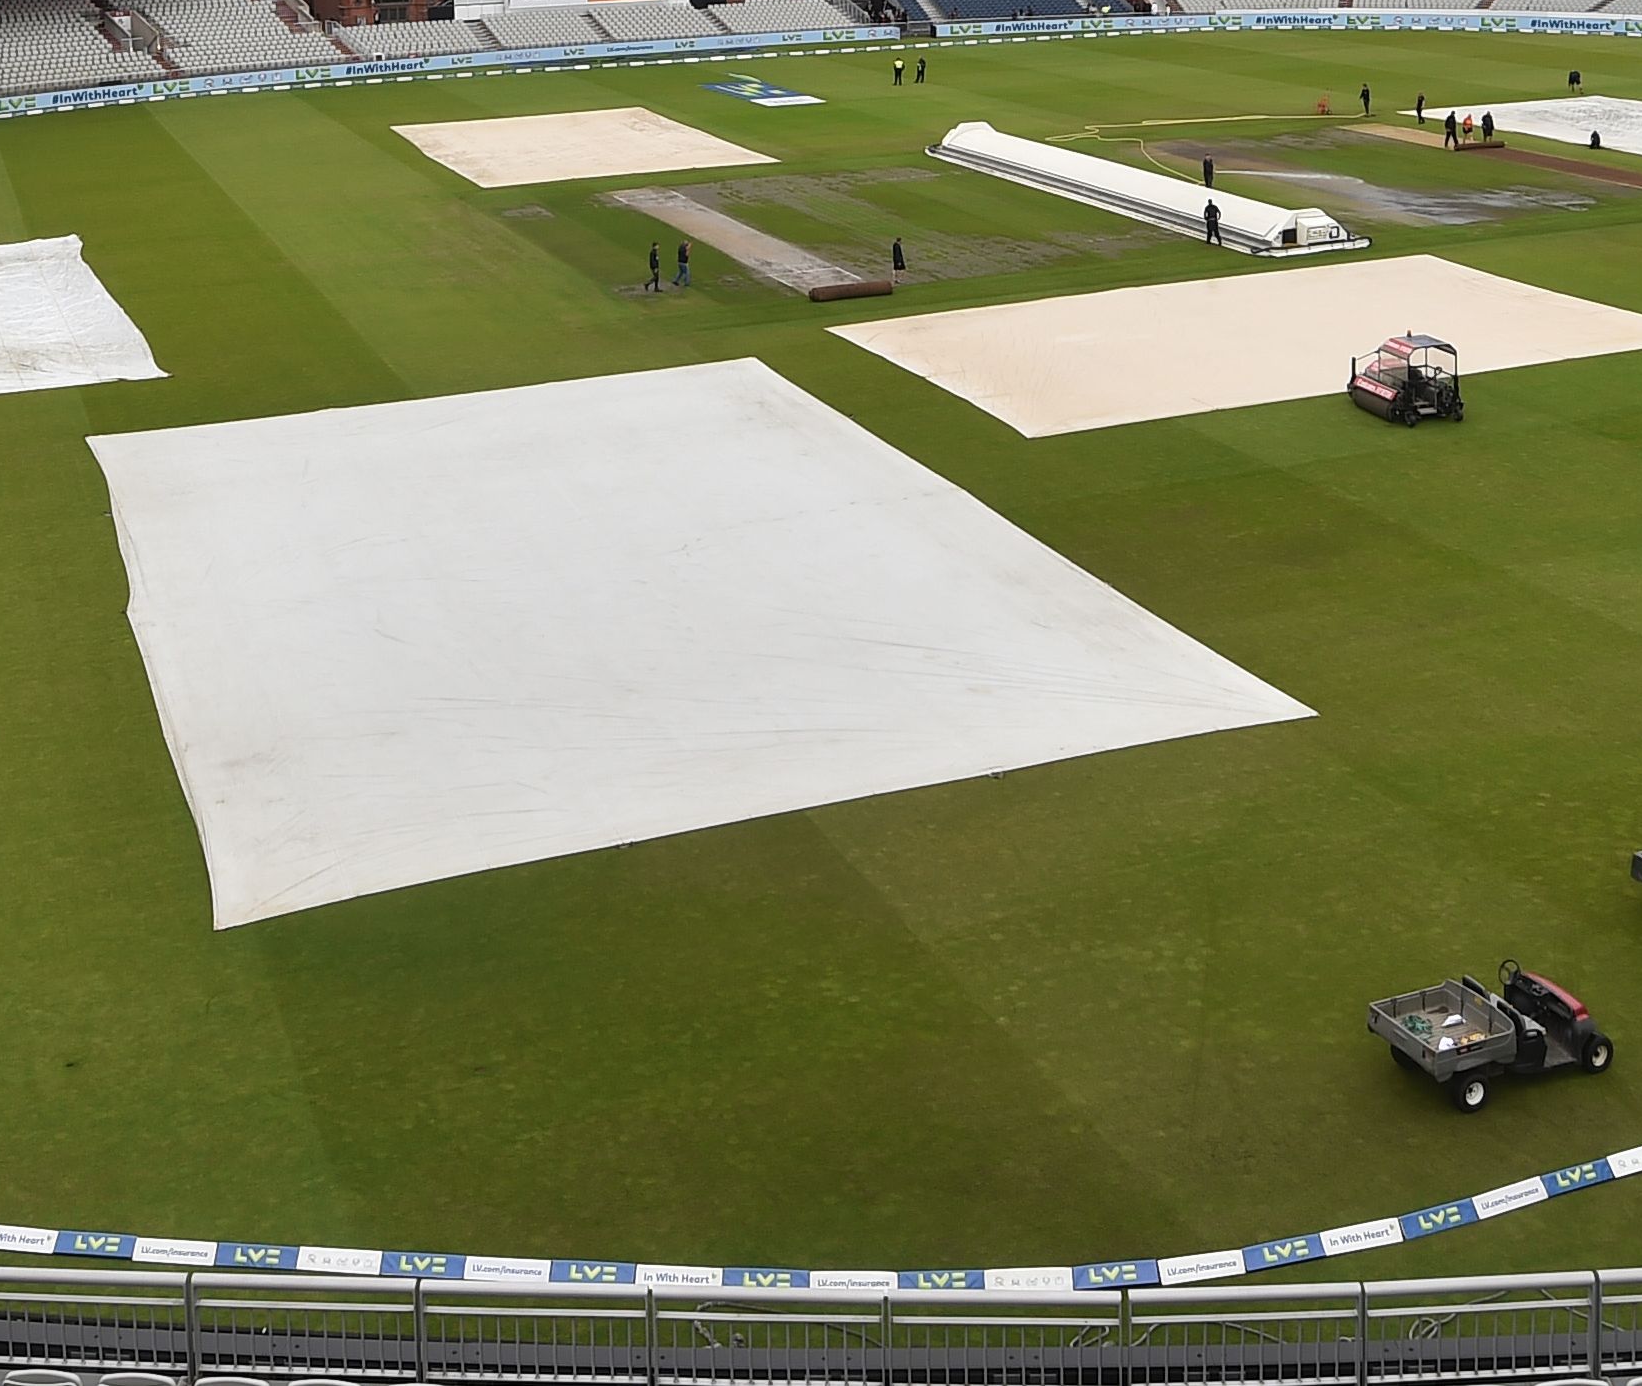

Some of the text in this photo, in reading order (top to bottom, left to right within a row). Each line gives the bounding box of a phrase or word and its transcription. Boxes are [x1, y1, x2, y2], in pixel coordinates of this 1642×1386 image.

[1256, 15, 1333, 25] #InWithHeart
[1530, 19, 1610, 30] #InWithHeart
[995, 22, 1068, 32] #InWithHeart
[346, 61, 424, 75] #InWithHeart
[52, 88, 138, 105] #InWithHeart
[19, 1235, 44, 1246] Heart
[1329, 1228, 1390, 1247] In With Heart
[472, 1264, 542, 1276] LV.com/insurance
[1166, 1260, 1237, 1277] LV.com/insurance
[655, 1272, 709, 1284] With Heart
